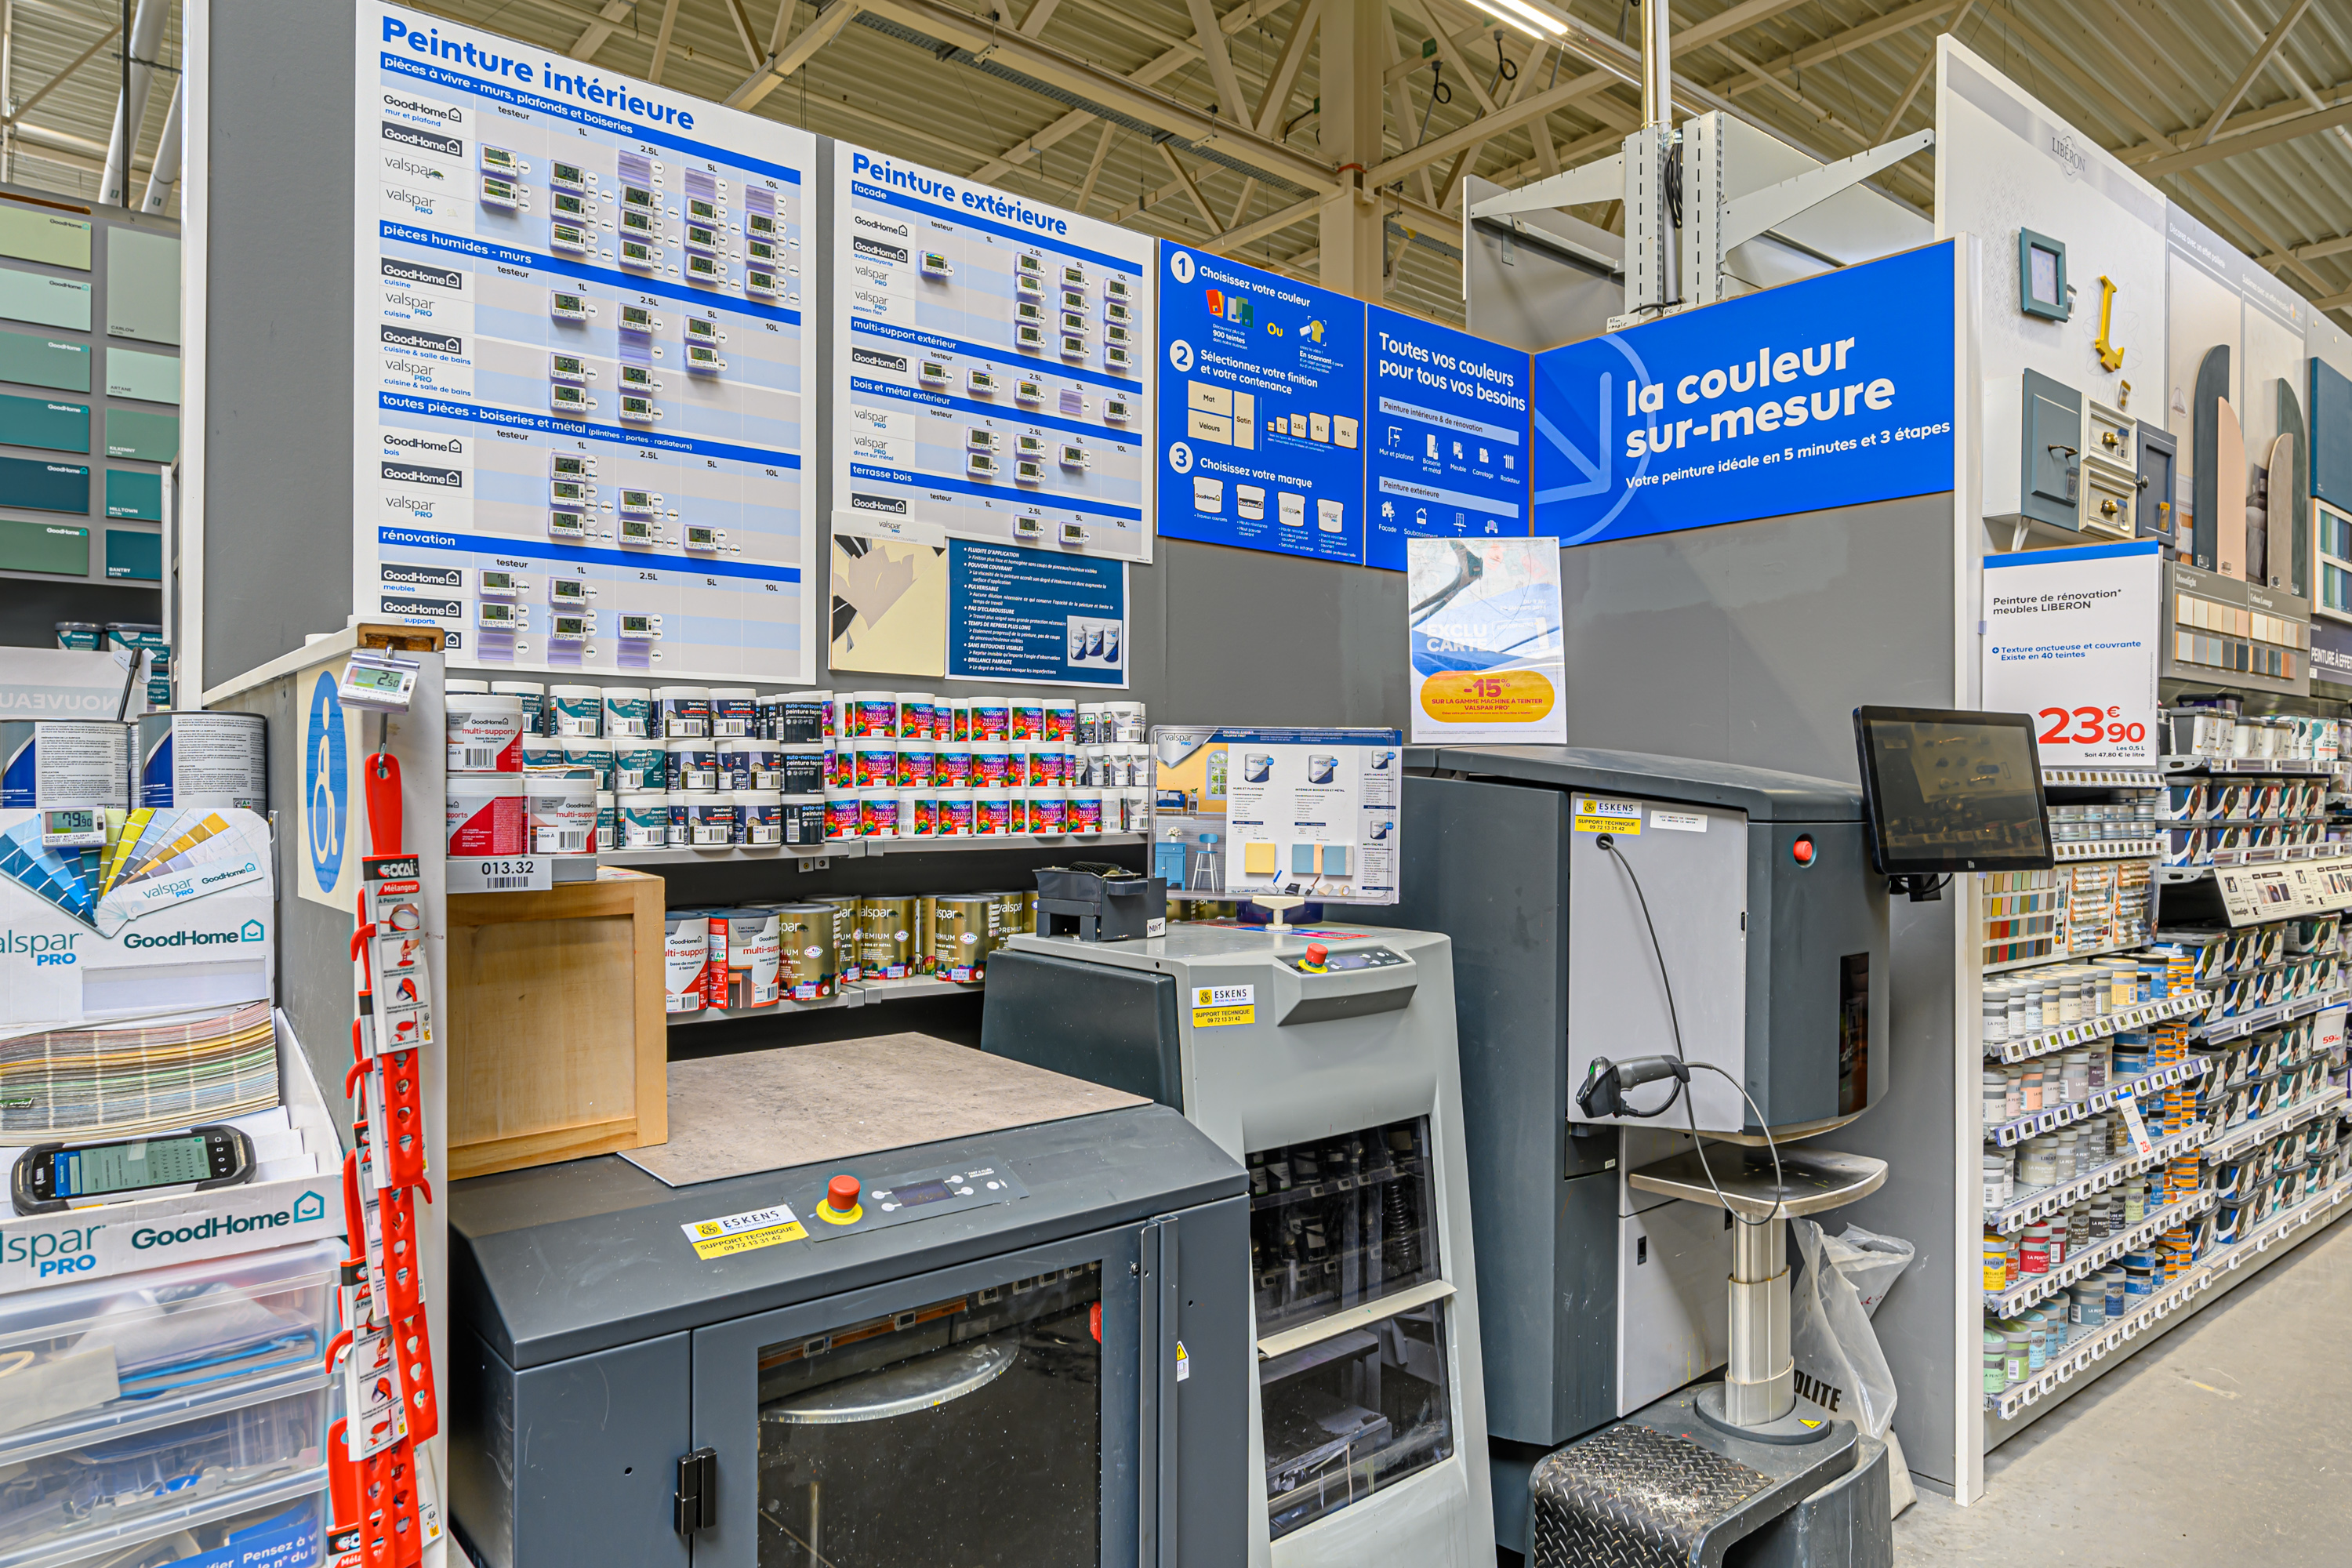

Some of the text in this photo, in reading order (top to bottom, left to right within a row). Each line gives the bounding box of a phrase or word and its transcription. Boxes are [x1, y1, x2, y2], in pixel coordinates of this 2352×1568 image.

[383, 16, 695, 130] Peinture intérieure
[383, 94, 448, 119] GoodHome
[384, 56, 633, 134] pièces à vivre murs, plafonds et boiseries
[385, 108, 401, 117] mur
[412, 114, 441, 127] plafond
[498, 105, 530, 121] testeur
[640, 145, 659, 157] 2.5L
[2052, 136, 2085, 172] LIBÉRON
[765, 180, 779, 190] 10L
[853, 152, 1067, 235] Peinture extérieure
[854, 183, 887, 201] façade
[386, 188, 434, 208] valspar
[415, 205, 434, 216] PRO
[383, 225, 532, 264] pièces humides murs
[1178, 258, 1310, 307] 1 Choisissez votre couleur
[854, 319, 956, 349] multi-support extérieur
[1213, 330, 1225, 339] 900
[1226, 332, 1245, 344] teintes
[1267, 322, 1283, 337] Ou
[384, 345, 411, 356] cuisine
[420, 351, 437, 361] salle
[451, 356, 470, 365] bains
[1176, 345, 1318, 388] 2 Sélectionnez votre finition
[1379, 332, 1514, 387] Toutes vos couleurs
[1200, 365, 1292, 395] et votre contenance
[1380, 359, 1526, 412] pour tous vos besoins
[1628, 336, 1855, 417] la couleur
[854, 379, 873, 390] bois
[885, 384, 911, 398] métal
[913, 390, 950, 405] extérieur
[1203, 394, 1215, 403] Mat
[383, 394, 692, 451] toutes pièces boiseries et métal (plinthes portes radiateurs)
[1199, 422, 1221, 432] Velours
[1236, 416, 1251, 425] Satin
[1384, 401, 1409, 414] Peinture
[1410, 408, 1438, 422] intérieure
[1453, 419, 1483, 433] rénovation
[1625, 377, 1896, 459] sur-mesure
[1625, 421, 1951, 489] Votre peinture idéale en 5 minutes et 3 étapes
[853, 465, 912, 482] terrasse bois
[1175, 448, 1312, 488] 3 Choisissez votre marque
[383, 529, 456, 546] rénovation
[1993, 596, 2038, 605] Peinture
[2040, 593, 2054, 602] de
[1993, 601, 2091, 615] meubles LIBERON
[2038, 706, 2145, 744] 23 € 90
[1599, 803, 1634, 812] ESKENS
[201, 868, 245, 884] GoodHome
[481, 861, 534, 875] 013.32
[124, 930, 238, 949] GoodHome
[132, 1210, 289, 1249] GoodHome
[723, 1210, 779, 1228] ESKENS
[700, 1225, 795, 1250] SUPPORT TECHNIQUE
[40, 1255, 96, 1277] PRO
[243, 1537, 306, 1563] Pensez à
